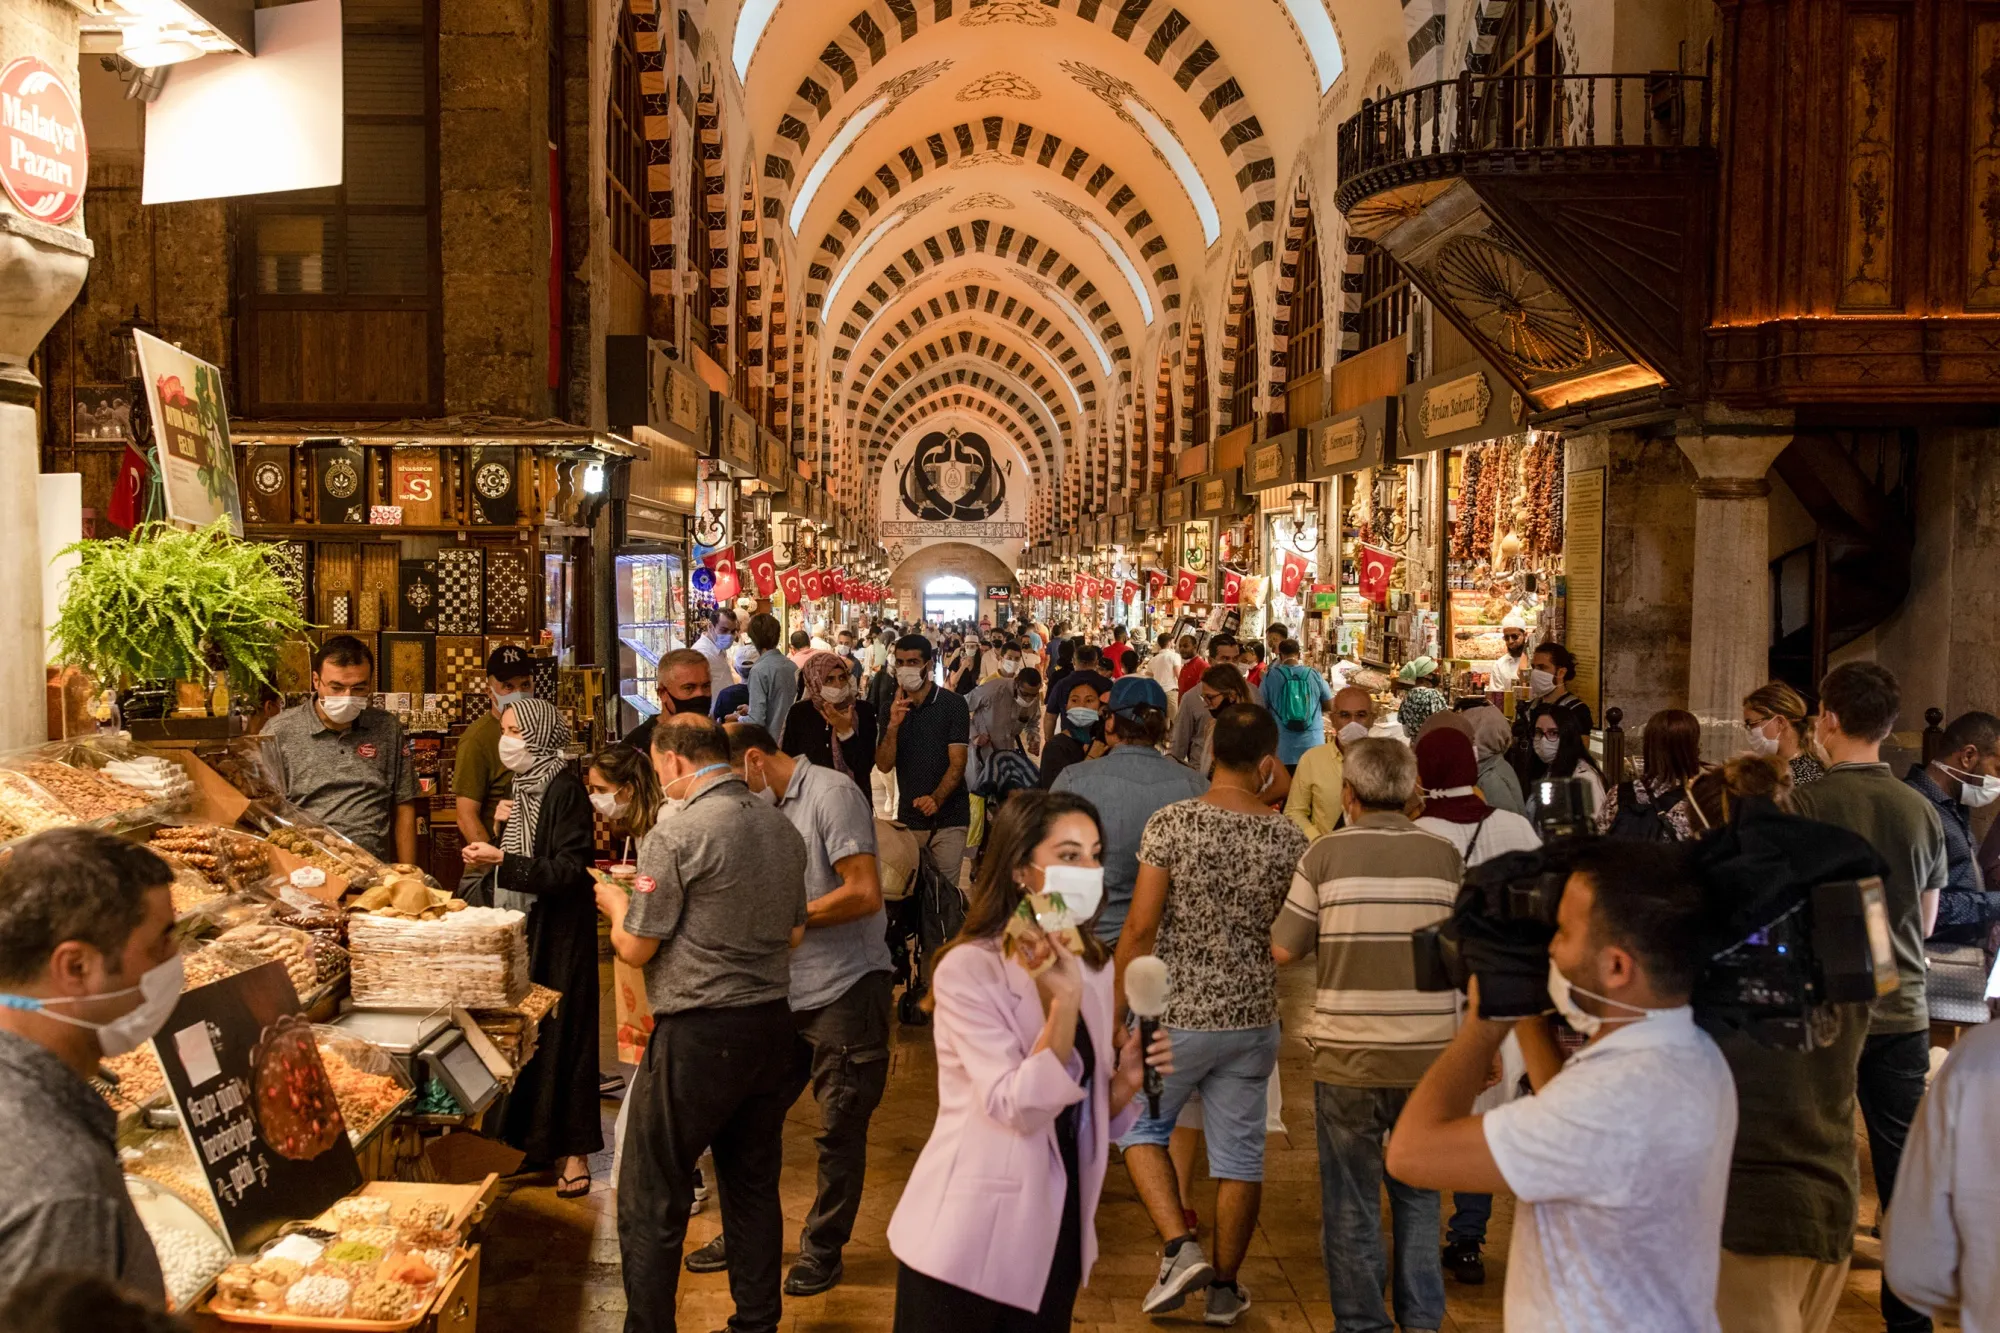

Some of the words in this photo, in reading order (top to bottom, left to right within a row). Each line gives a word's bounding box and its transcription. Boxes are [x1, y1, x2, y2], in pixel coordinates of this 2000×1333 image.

[2, 91, 77, 155] Malatya
[9, 135, 73, 188] Pazarı
[1450, 393, 1476, 418] Baharat
[503, 648, 521, 664] NY
